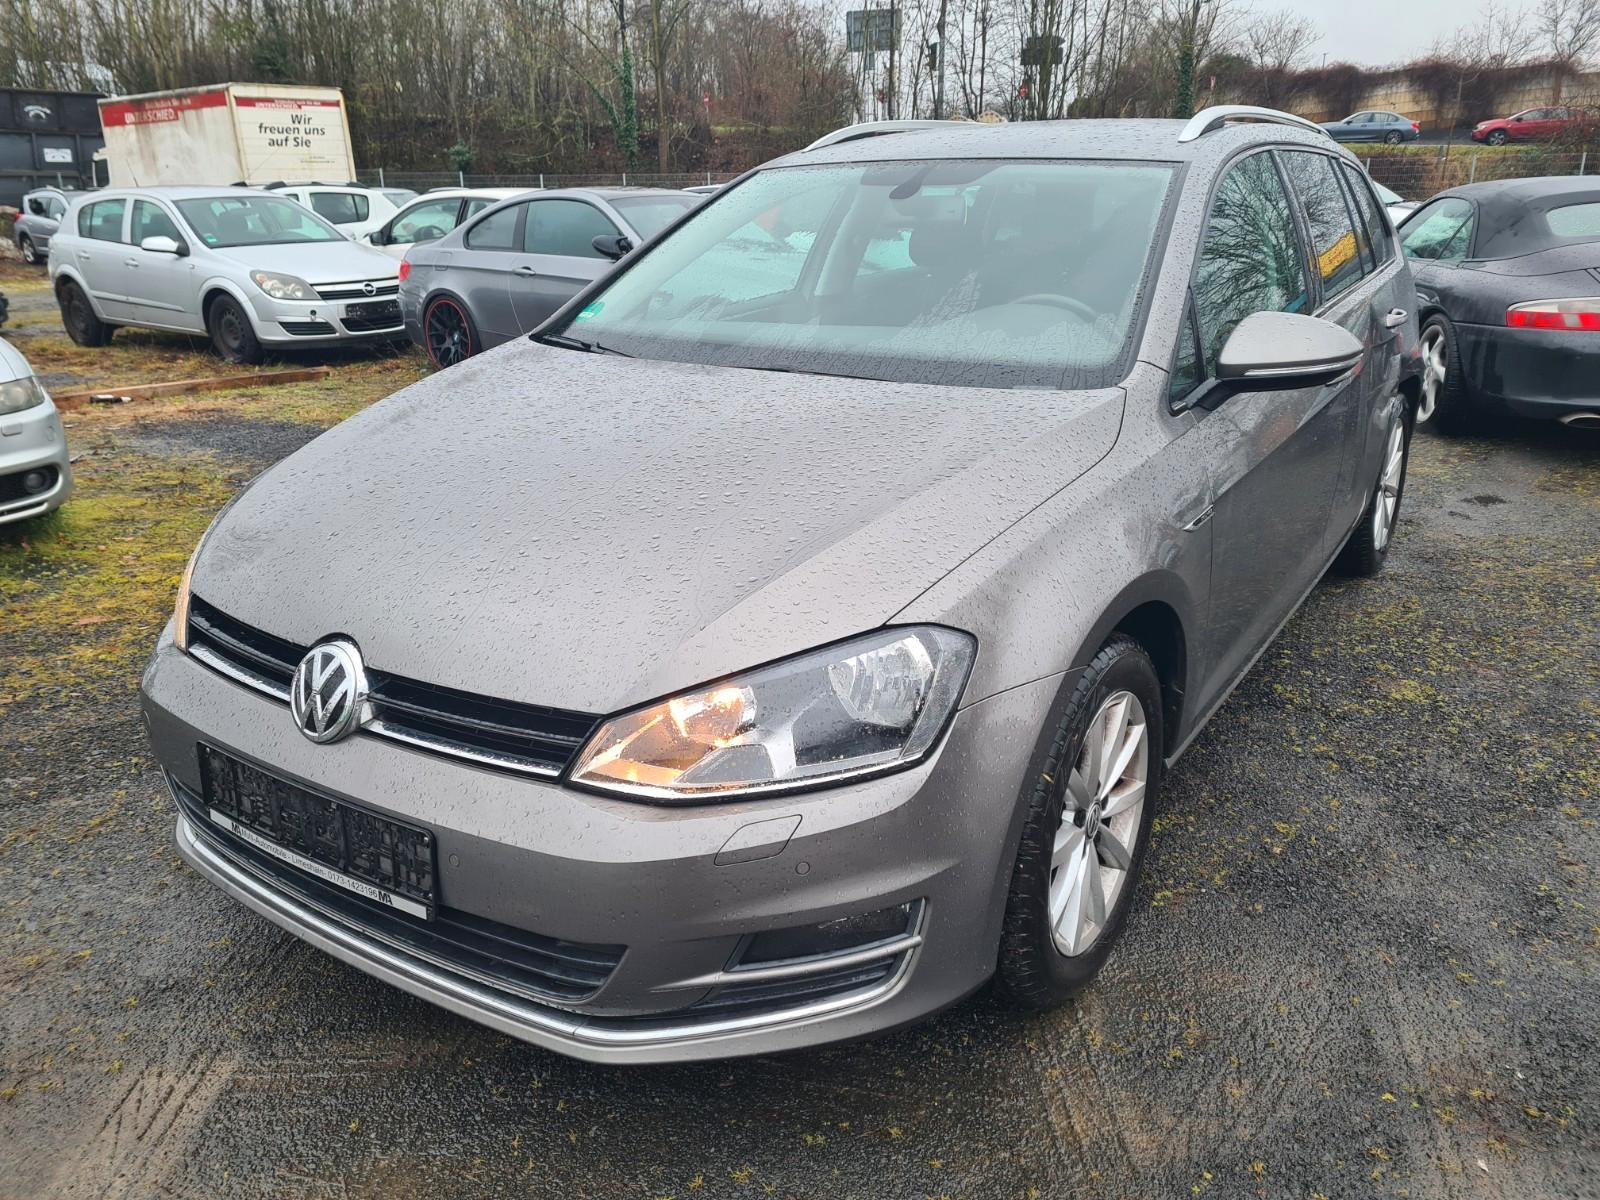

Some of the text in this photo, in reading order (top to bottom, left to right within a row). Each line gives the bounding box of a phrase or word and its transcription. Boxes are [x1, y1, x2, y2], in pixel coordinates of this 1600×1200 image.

[291, 113, 313, 125] Wir
[258, 122, 326, 136] freuen uns
[268, 135, 312, 148] auf Sie
